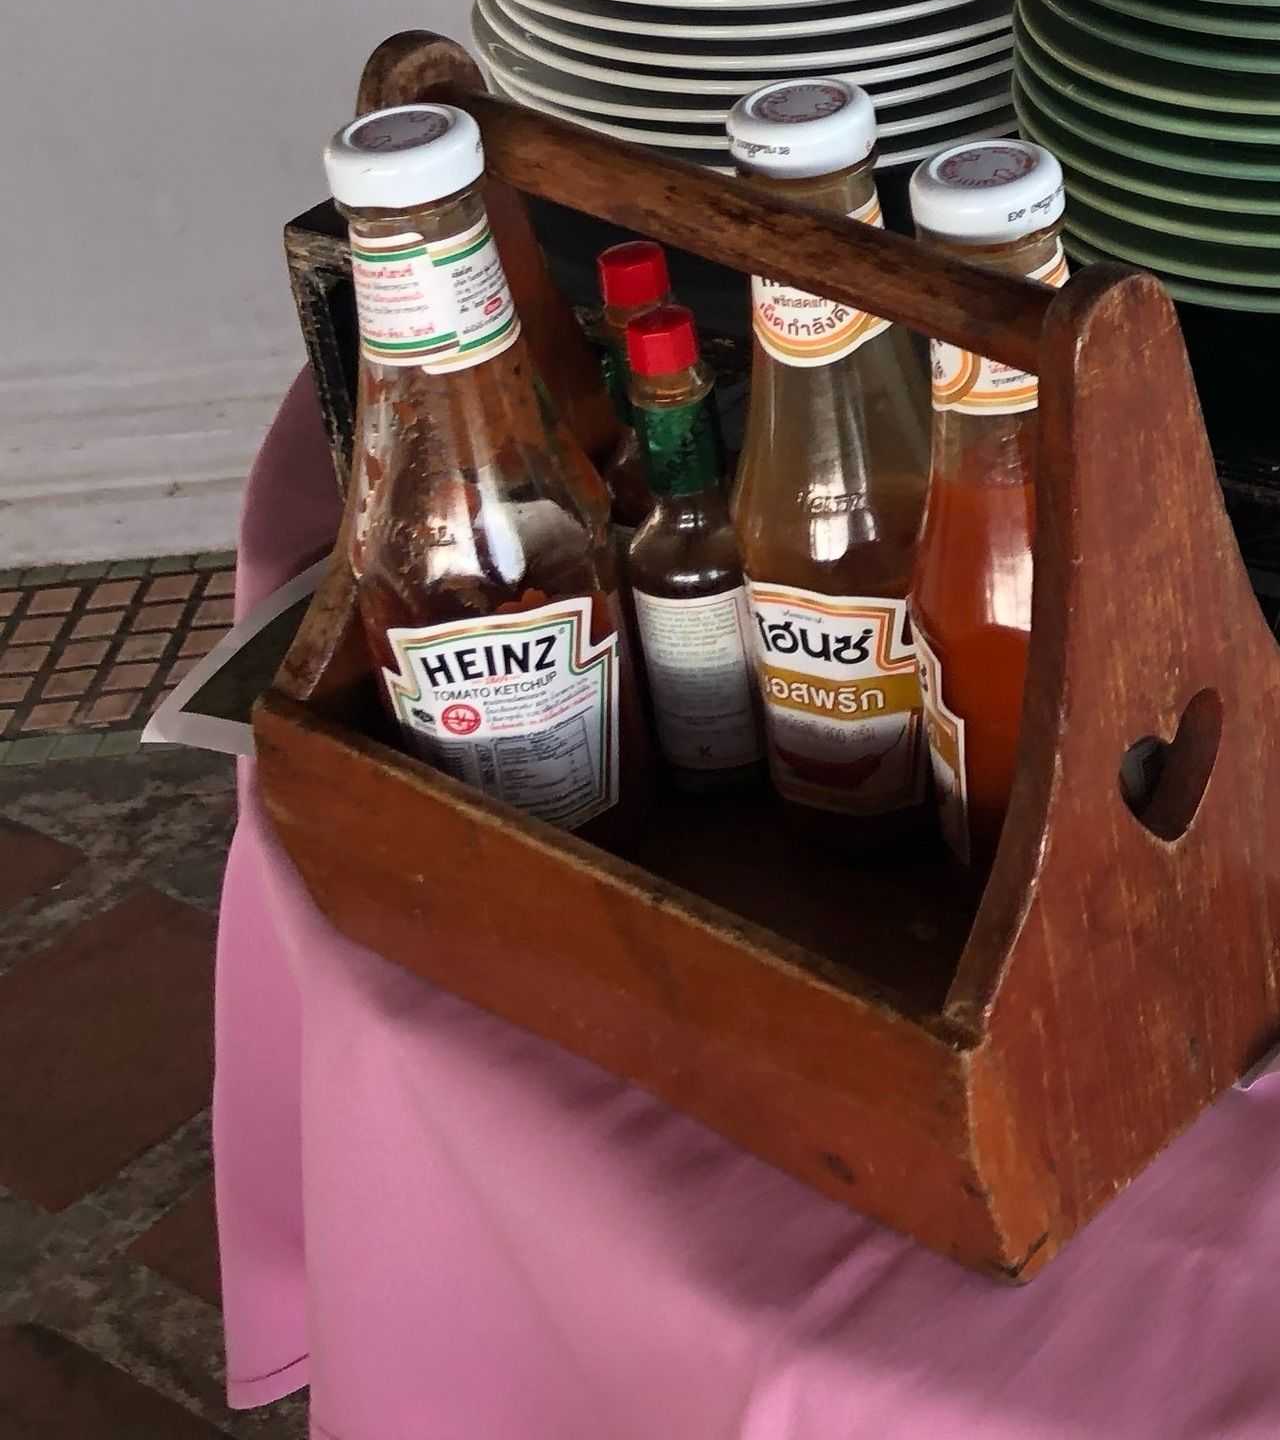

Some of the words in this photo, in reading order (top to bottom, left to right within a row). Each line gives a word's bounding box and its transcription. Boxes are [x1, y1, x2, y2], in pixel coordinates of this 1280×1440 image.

[1008, 208, 1026, 222] EXP
[755, 611, 874, 664] ไฮนซ์
[420, 637, 557, 687] HEINZ
[432, 687, 491, 702] TOMATO
[494, 670, 557, 697] KETCHUP
